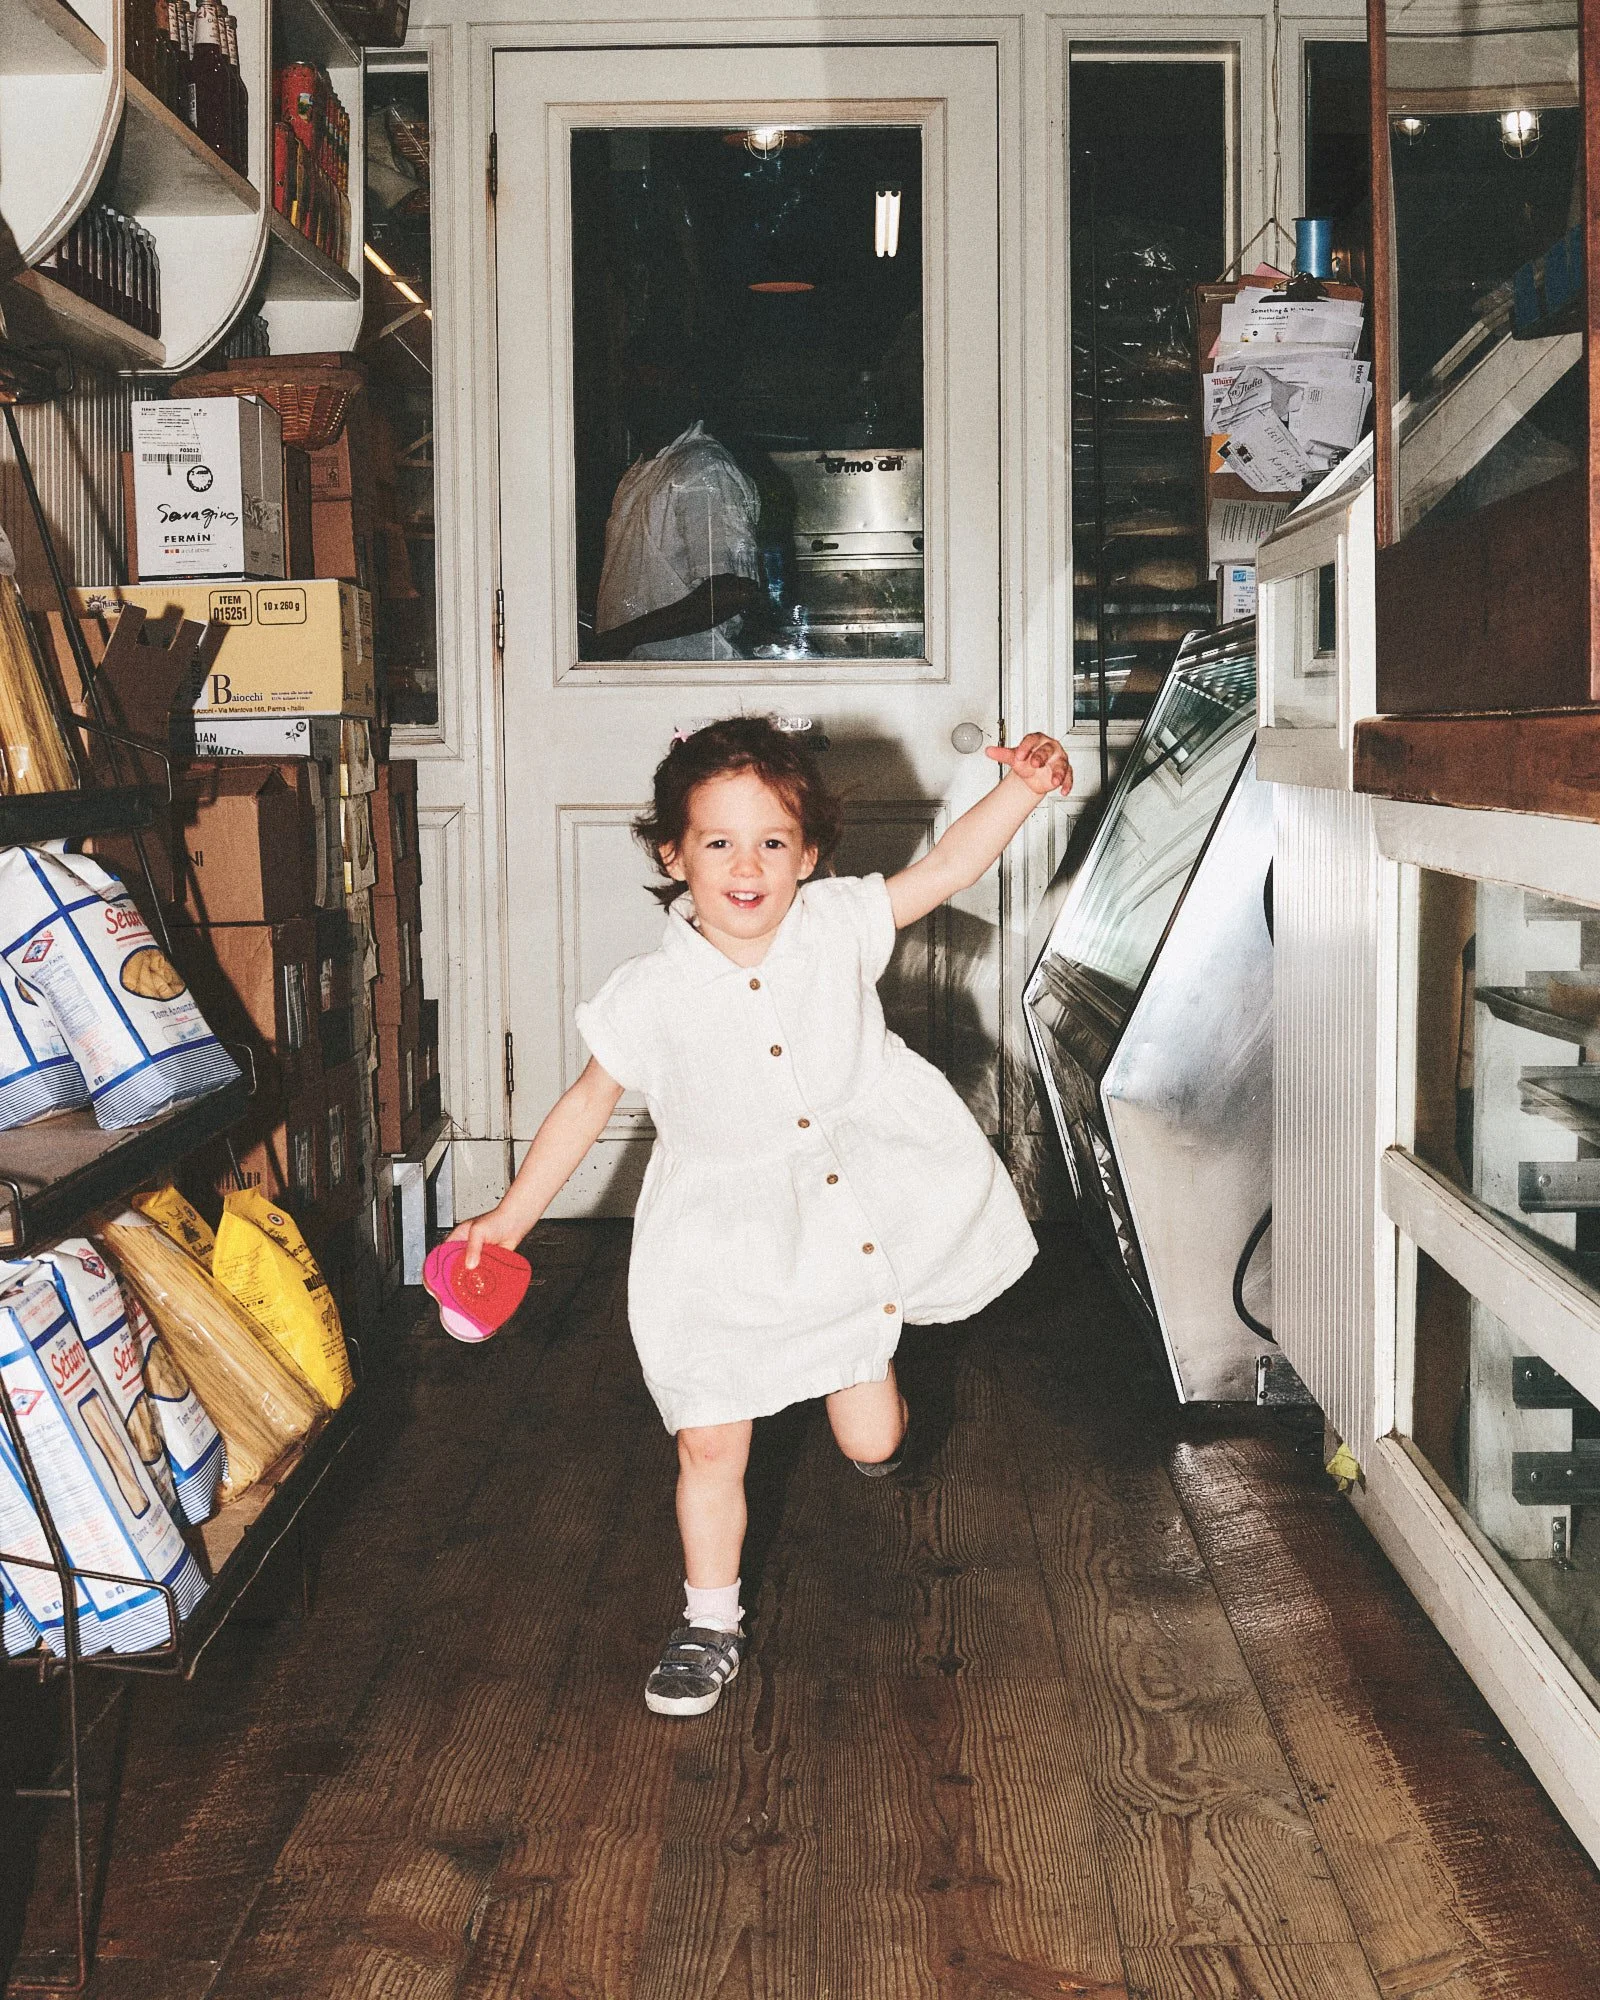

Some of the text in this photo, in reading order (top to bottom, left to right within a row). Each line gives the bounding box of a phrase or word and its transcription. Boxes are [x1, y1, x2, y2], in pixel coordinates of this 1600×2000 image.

[164, 532, 211, 543] FERMÍN
[219, 595, 242, 605] ITEM
[263, 601, 300, 612] 10 x 260 g
[213, 607, 248, 621] 015251
[210, 674, 263, 705] Baiocchi
